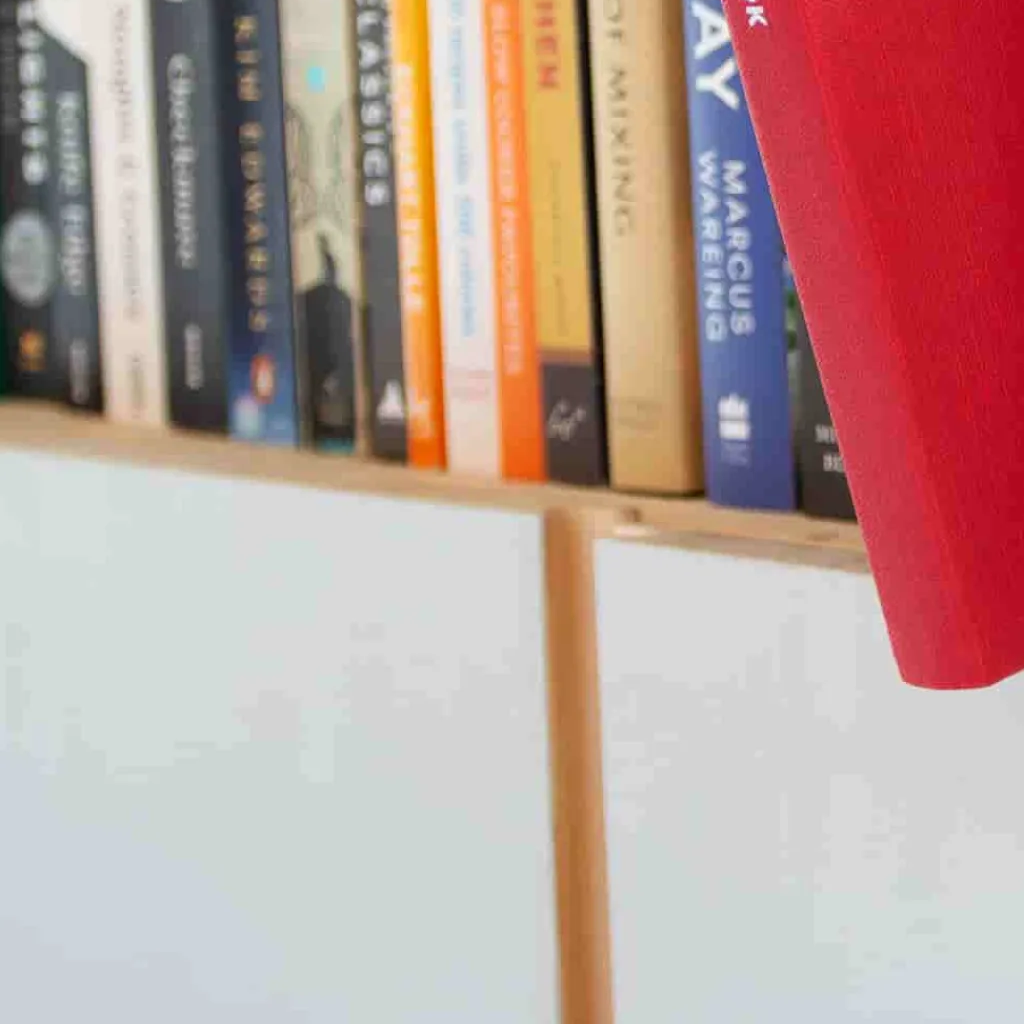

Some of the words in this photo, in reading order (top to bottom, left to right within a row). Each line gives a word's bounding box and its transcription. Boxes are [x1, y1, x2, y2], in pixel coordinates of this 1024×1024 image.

[609, 67, 635, 239] MIXING
[698, 148, 729, 343] WAREING
[722, 159, 757, 337] MARCUS
